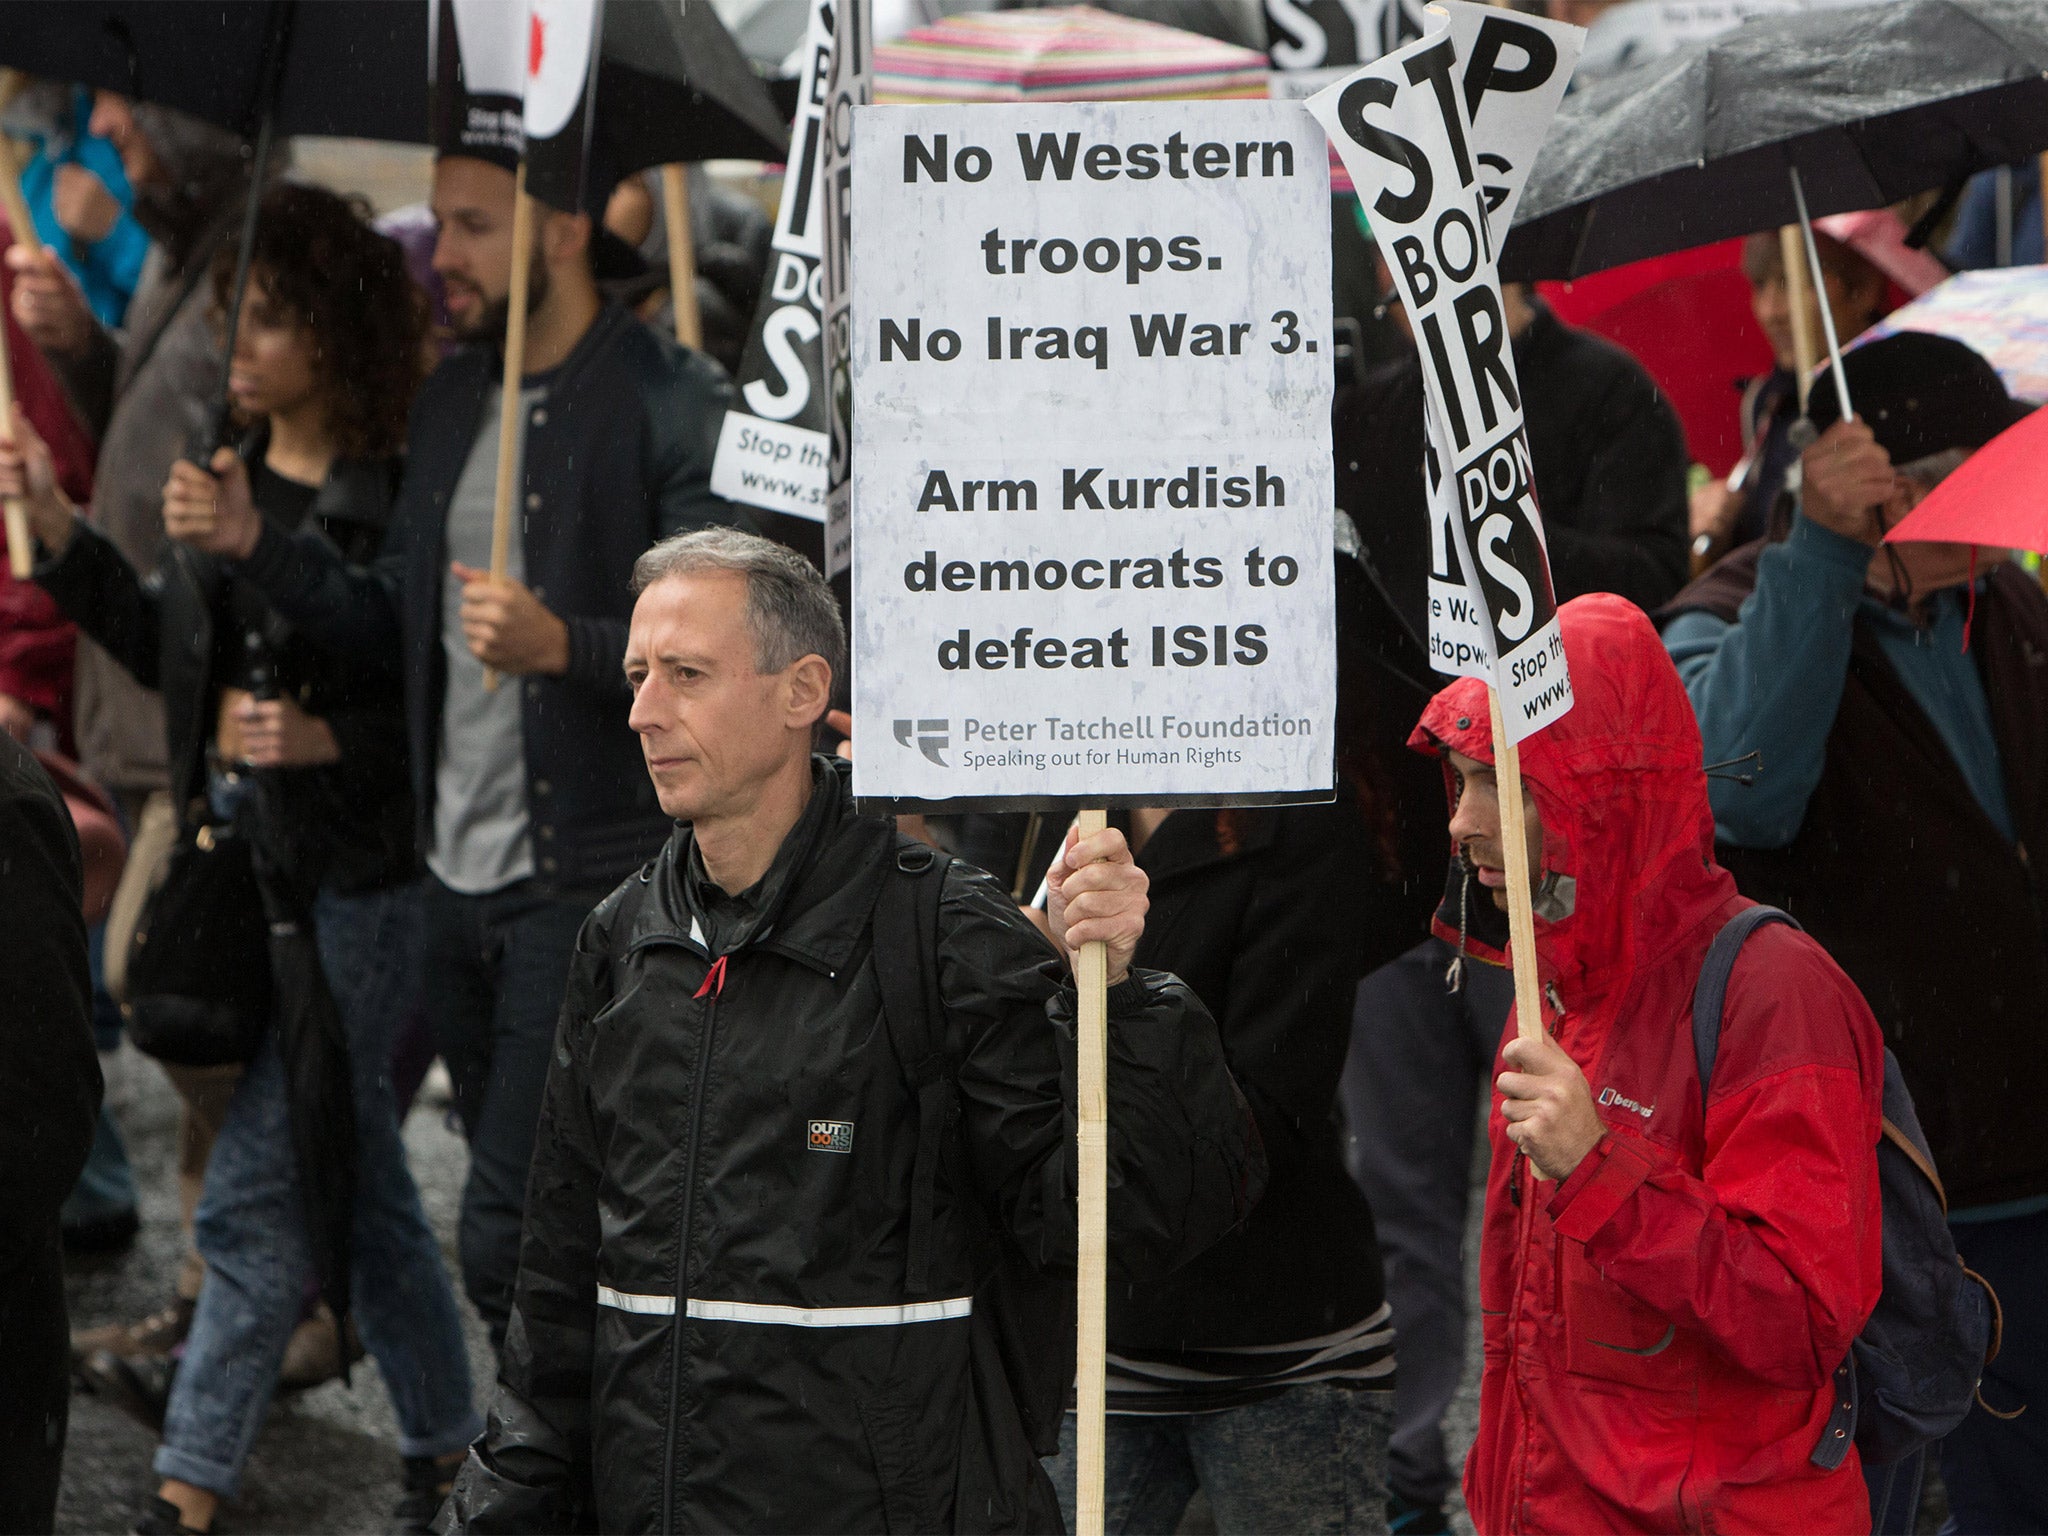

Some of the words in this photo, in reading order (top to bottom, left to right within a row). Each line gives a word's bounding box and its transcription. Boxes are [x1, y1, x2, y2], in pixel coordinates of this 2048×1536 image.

[902, 134, 993, 183] No
[1016, 130, 1294, 181] Western
[981, 228, 1222, 284] troops.
[879, 318, 962, 362] No
[987, 316, 1108, 370] Iraq
[1130, 313, 1252, 358] War
[1270, 310, 1318, 354] 3.
[738, 427, 792, 464] Stop
[800, 443, 829, 468] th
[917, 470, 1038, 512] Arm
[1062, 465, 1286, 511] Kurdish
[903, 546, 1224, 592] democrats
[1244, 546, 1299, 587] to
[937, 627, 1129, 670] defeat
[1152, 624, 1269, 667] ISIS
[1511, 650, 1547, 688] Stop
[963, 717, 1038, 742] Peter
[1045, 716, 1154, 741] Tatchell
[1161, 714, 1312, 740] Foundation
[963, 749, 1046, 772] Speaking
[1050, 750, 1082, 768] out
[1086, 748, 1111, 766] for
[1116, 748, 1180, 766] Human
[1186, 746, 1242, 767] Rights
[811, 1122, 850, 1136] OUTD
[811, 1133, 850, 1147] OORS
